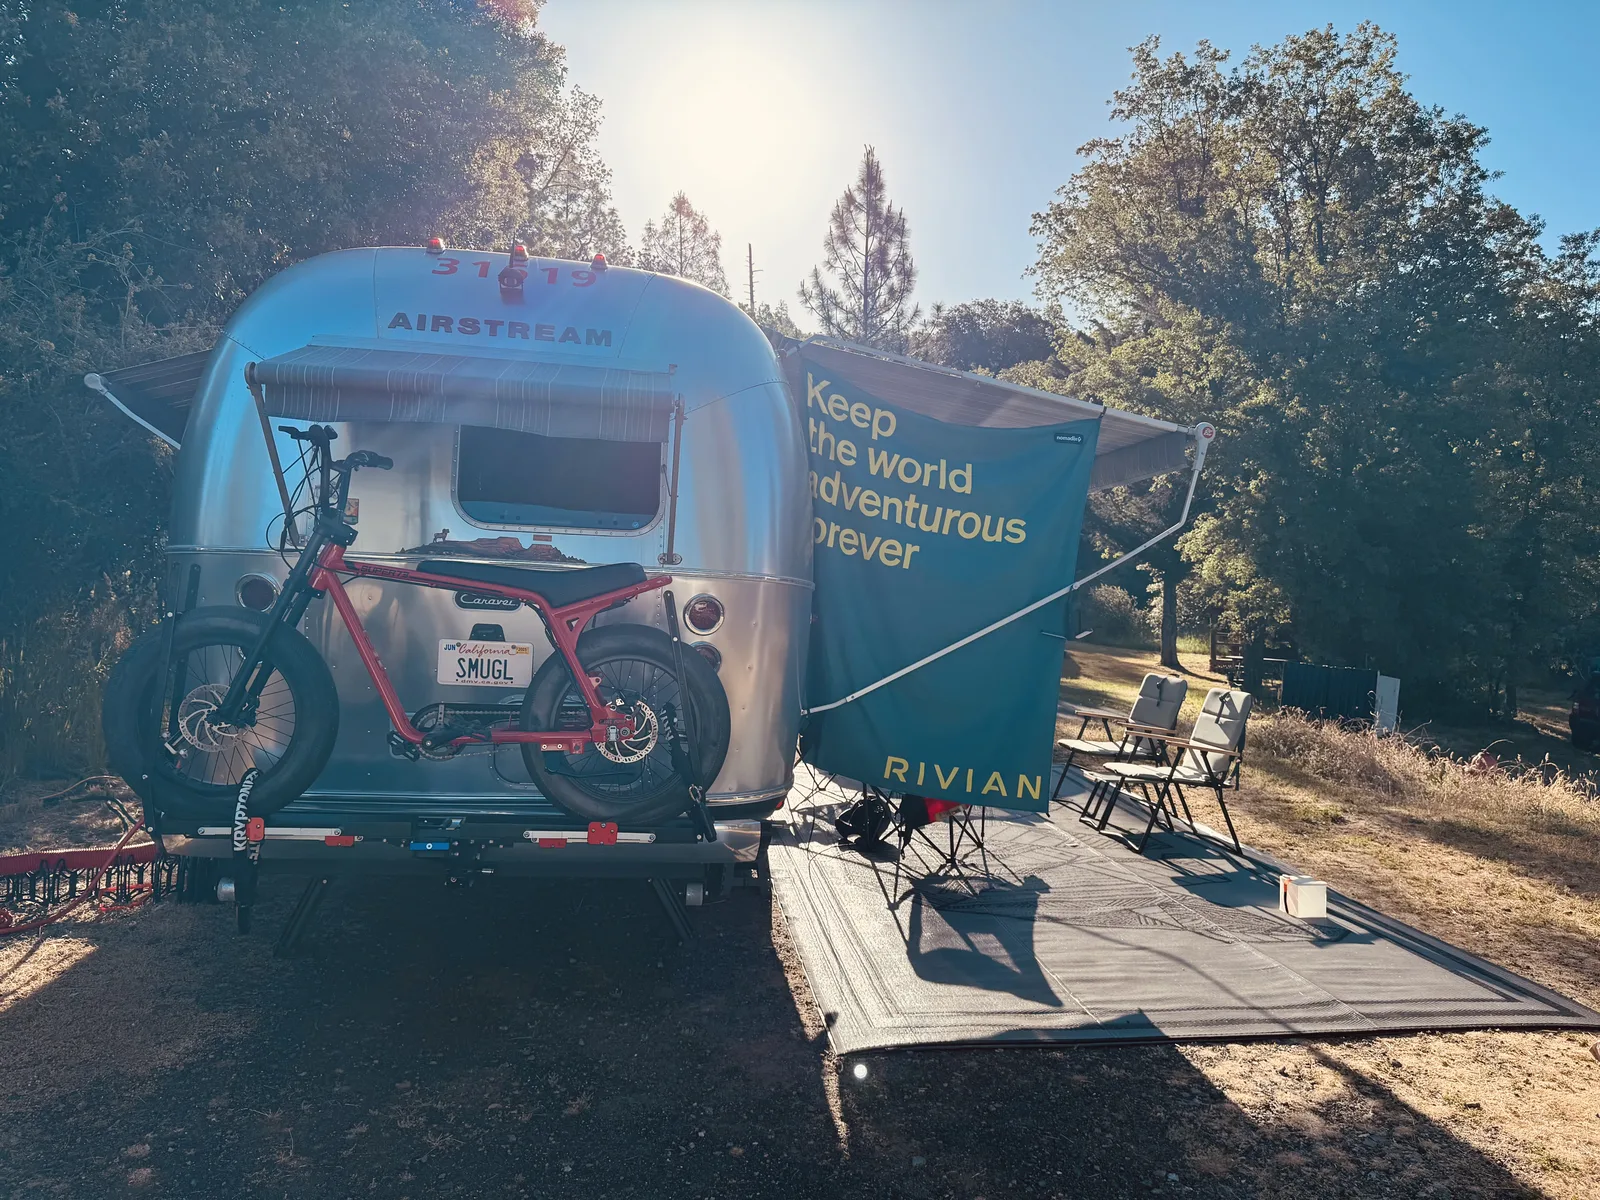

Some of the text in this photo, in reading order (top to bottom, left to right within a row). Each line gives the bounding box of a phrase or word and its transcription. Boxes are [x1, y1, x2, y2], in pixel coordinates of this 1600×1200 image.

[431, 257, 597, 287] 3119
[388, 312, 612, 347] AIRSTREAM
[807, 372, 897, 440] Keep
[808, 416, 973, 495] the world
[813, 516, 920, 570] orever
[443, 643, 456, 651] JUN
[458, 643, 516, 658] California
[455, 657, 514, 681] SMUGL
[883, 755, 1042, 800] RIVIAN
